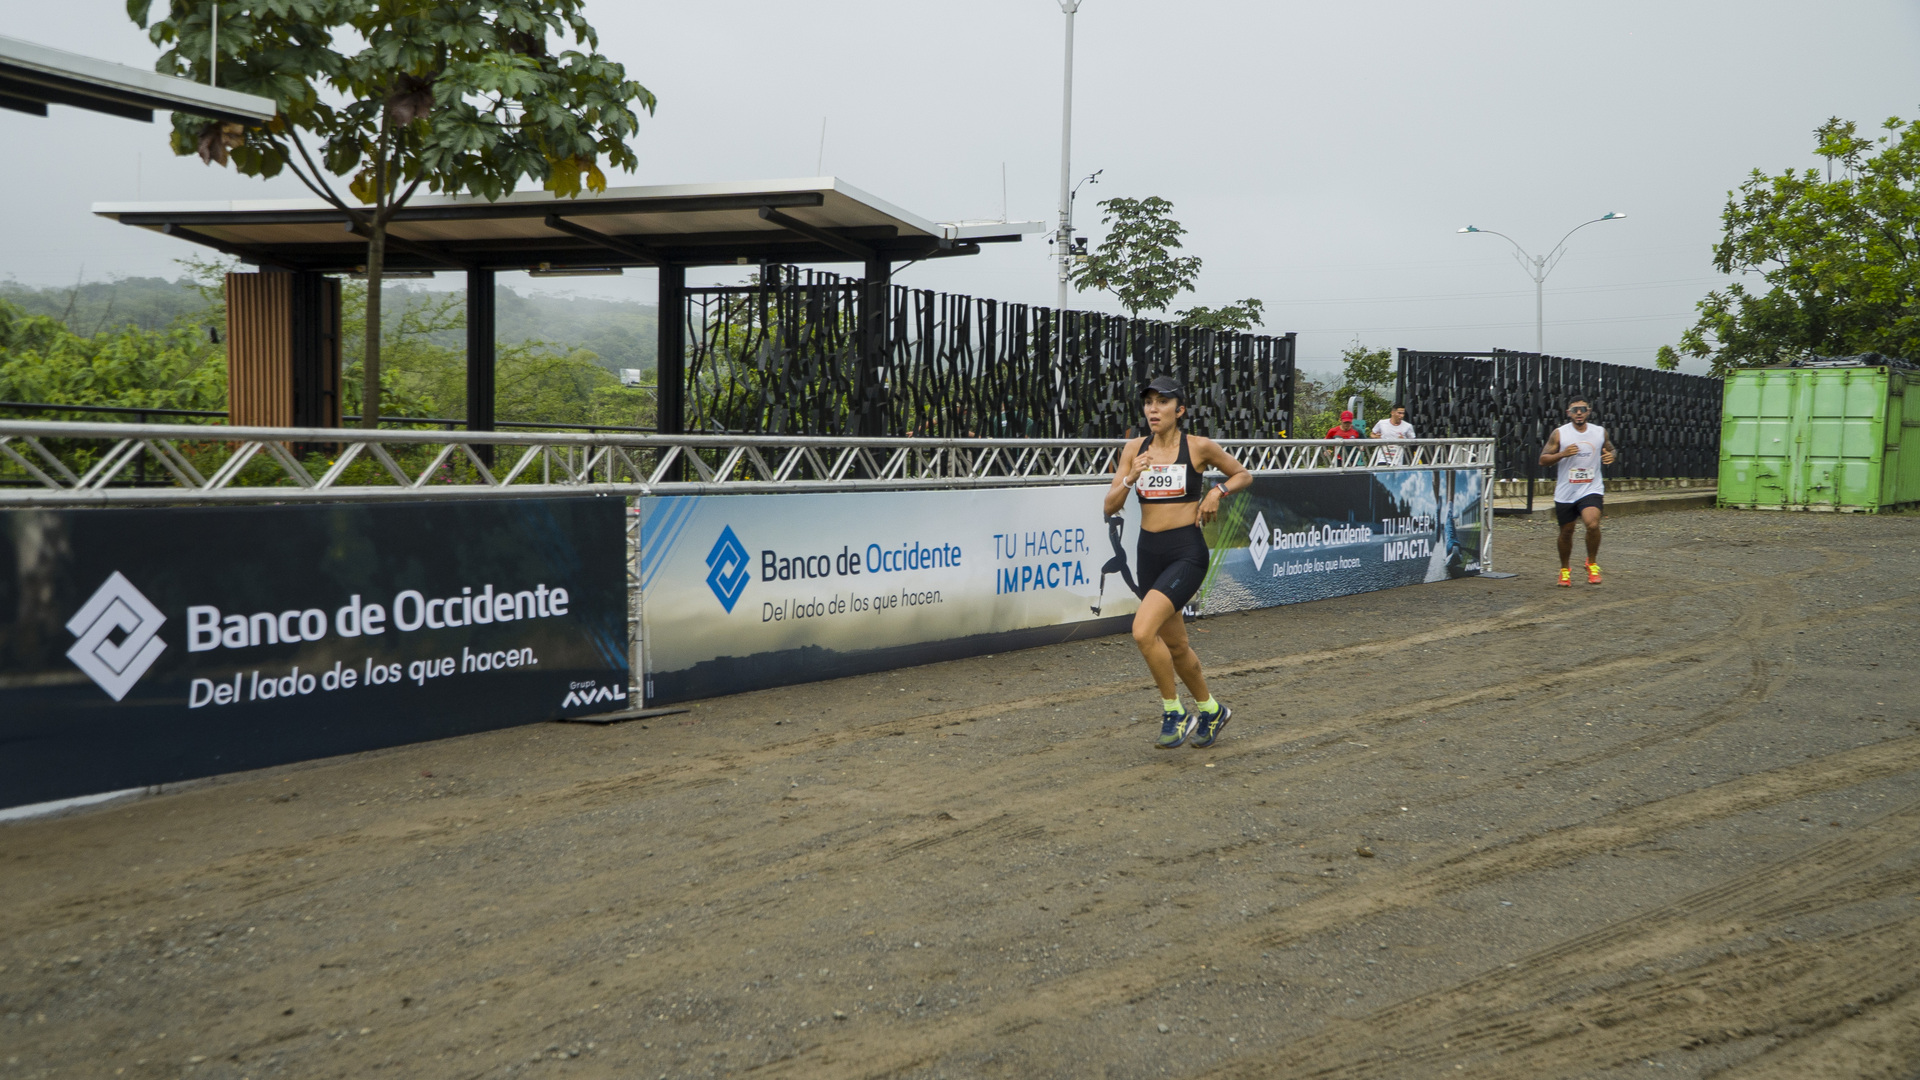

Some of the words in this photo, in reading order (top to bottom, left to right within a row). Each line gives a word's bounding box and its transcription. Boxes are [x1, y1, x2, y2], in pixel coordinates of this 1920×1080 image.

[1148, 475, 1172, 487] 299
[1274, 528, 1306, 550] Banco
[1308, 526, 1321, 547] de
[1322, 524, 1371, 545] Occidente
[1382, 518, 1395, 537] TU
[1398, 516, 1432, 536] HACER,
[993, 533, 1019, 559] TU
[1024, 528, 1090, 558] HACER,
[1383, 539, 1432, 562] IMPACTA.
[761, 550, 831, 582] Banco
[836, 546, 861, 575] de
[866, 542, 962, 574] Occidente
[1273, 562, 1286, 577] Del
[1287, 560, 1302, 575] lado
[1304, 559, 1312, 573] de
[1314, 558, 1324, 572] los
[1326, 559, 1338, 573] que
[1339, 555, 1360, 570] hacen.
[996, 561, 1090, 595] IMPACTA.
[187, 604, 327, 652] Banco
[335, 594, 385, 637] de
[393, 584, 568, 632] Occidente
[762, 601, 787, 622] Del
[792, 598, 824, 619] lado
[828, 596, 846, 615] de
[850, 593, 870, 612] los
[873, 594, 897, 615] que
[901, 588, 943, 608] hacen.
[188, 674, 241, 709] Del
[250, 667, 317, 702] lado
[321, 661, 356, 690] de
[365, 657, 402, 686] los
[410, 654, 456, 686] que
[461, 646, 538, 673] hacen.
[570, 680, 596, 690] Grupo
[561, 684, 626, 709] AVAL
